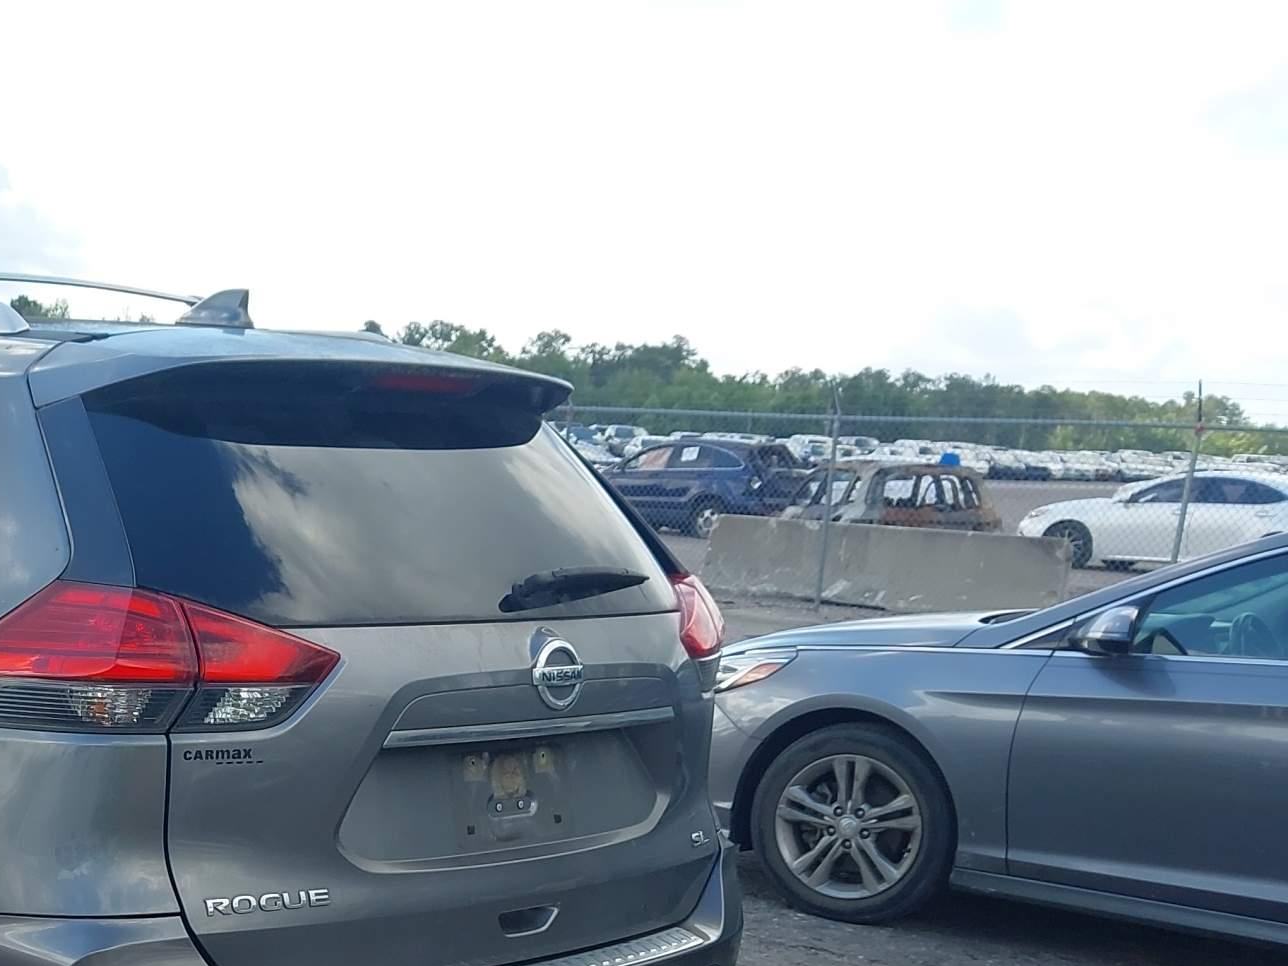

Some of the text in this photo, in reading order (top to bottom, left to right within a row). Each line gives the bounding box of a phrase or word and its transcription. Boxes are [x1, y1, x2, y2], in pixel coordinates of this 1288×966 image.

[541, 670, 583, 682] NISSAN
[691, 831, 710, 847] SL
[203, 888, 331, 917] ROGUE
